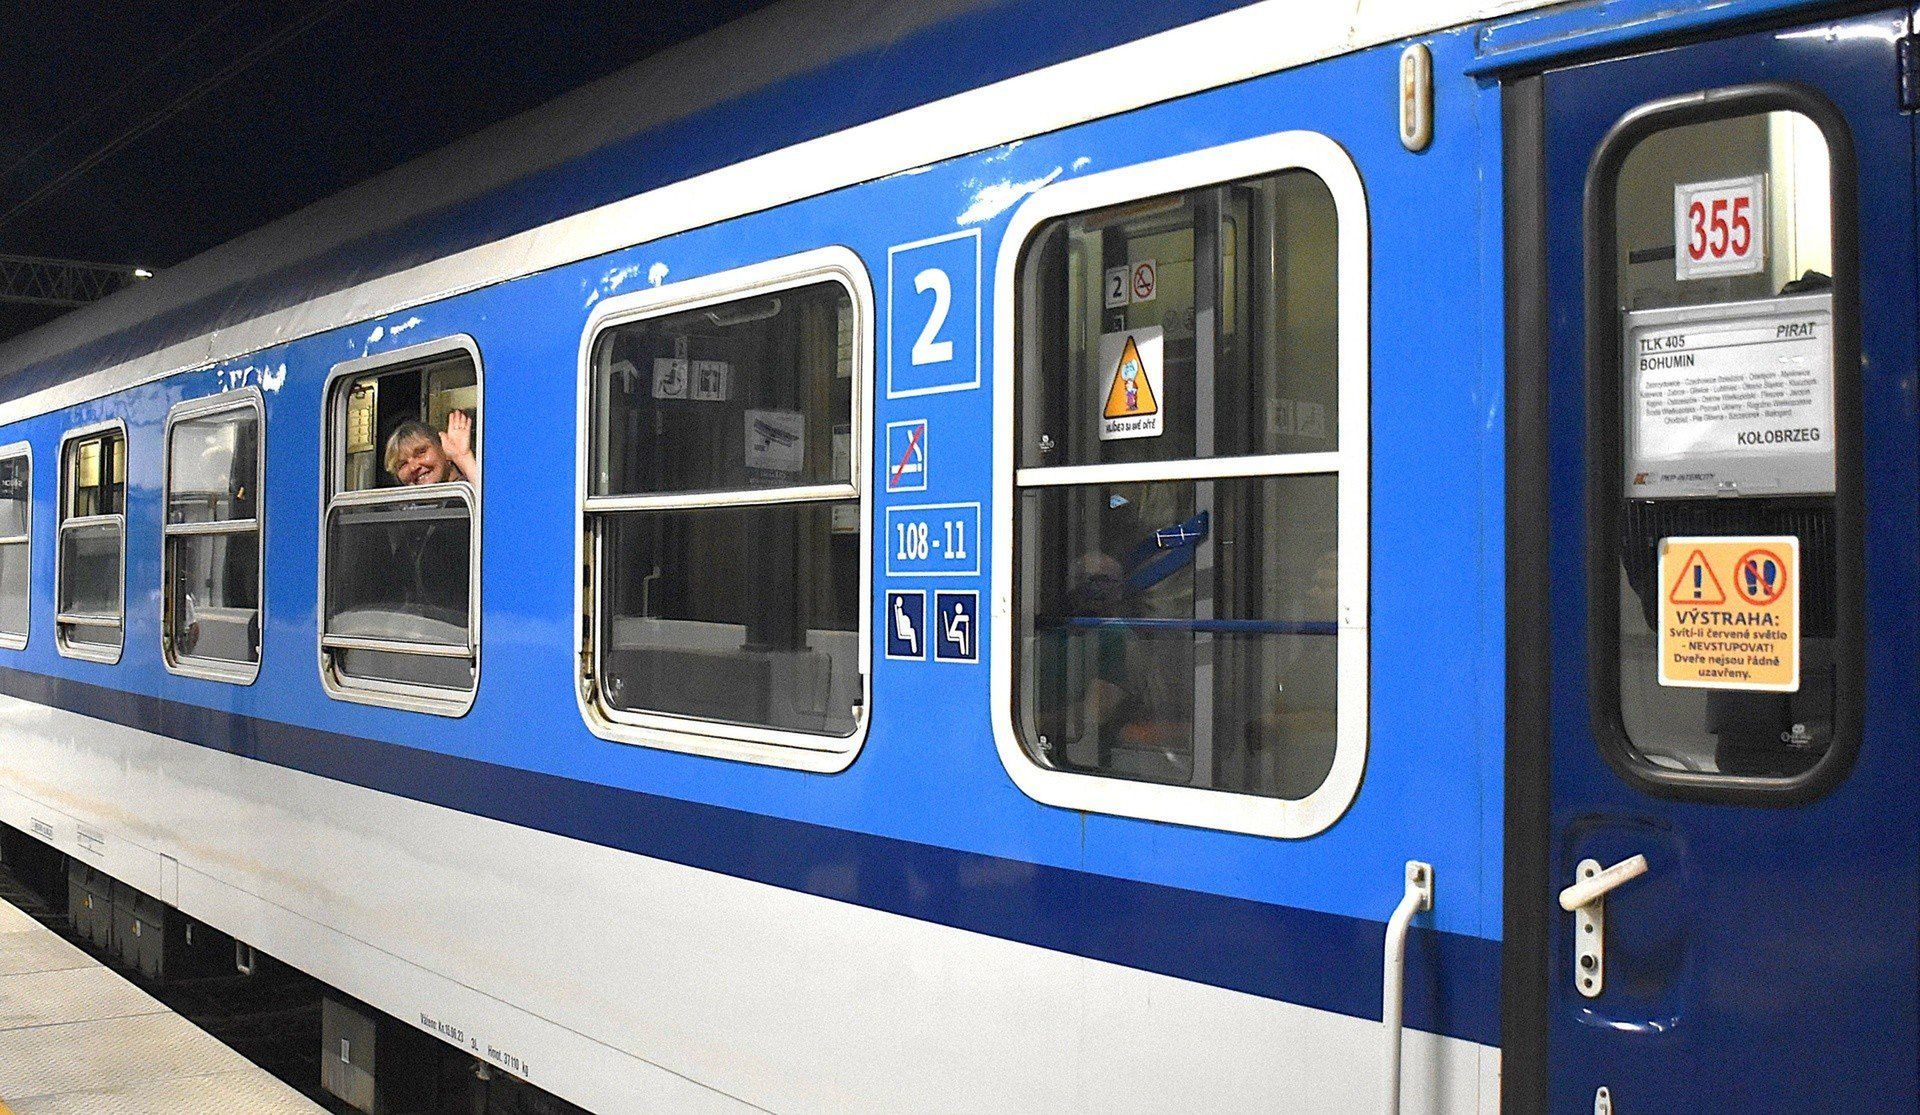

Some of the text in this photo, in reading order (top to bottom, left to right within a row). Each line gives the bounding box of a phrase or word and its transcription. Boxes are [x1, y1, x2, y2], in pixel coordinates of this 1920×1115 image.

[1688, 196, 1751, 260] 355
[1112, 275, 1122, 298] 2
[911, 267, 954, 366] 2
[1776, 321, 1817, 338] PIRAT
[1640, 335, 1685, 352] TLK 405
[1640, 353, 1695, 372] BOHUMIN
[1738, 427, 1820, 446] KOŁOBRZEG
[896, 522, 929, 560] 108
[944, 520, 967, 560] 11
[1676, 606, 1780, 626] VÝSTRAHA:
[1706, 628, 1750, 640] červené
[1688, 641, 1774, 653] NEVSTUPOVAT!
[1674, 653, 1780, 666] Dveře nejsou řádně
[1698, 668, 1752, 680] uzavřeny.
